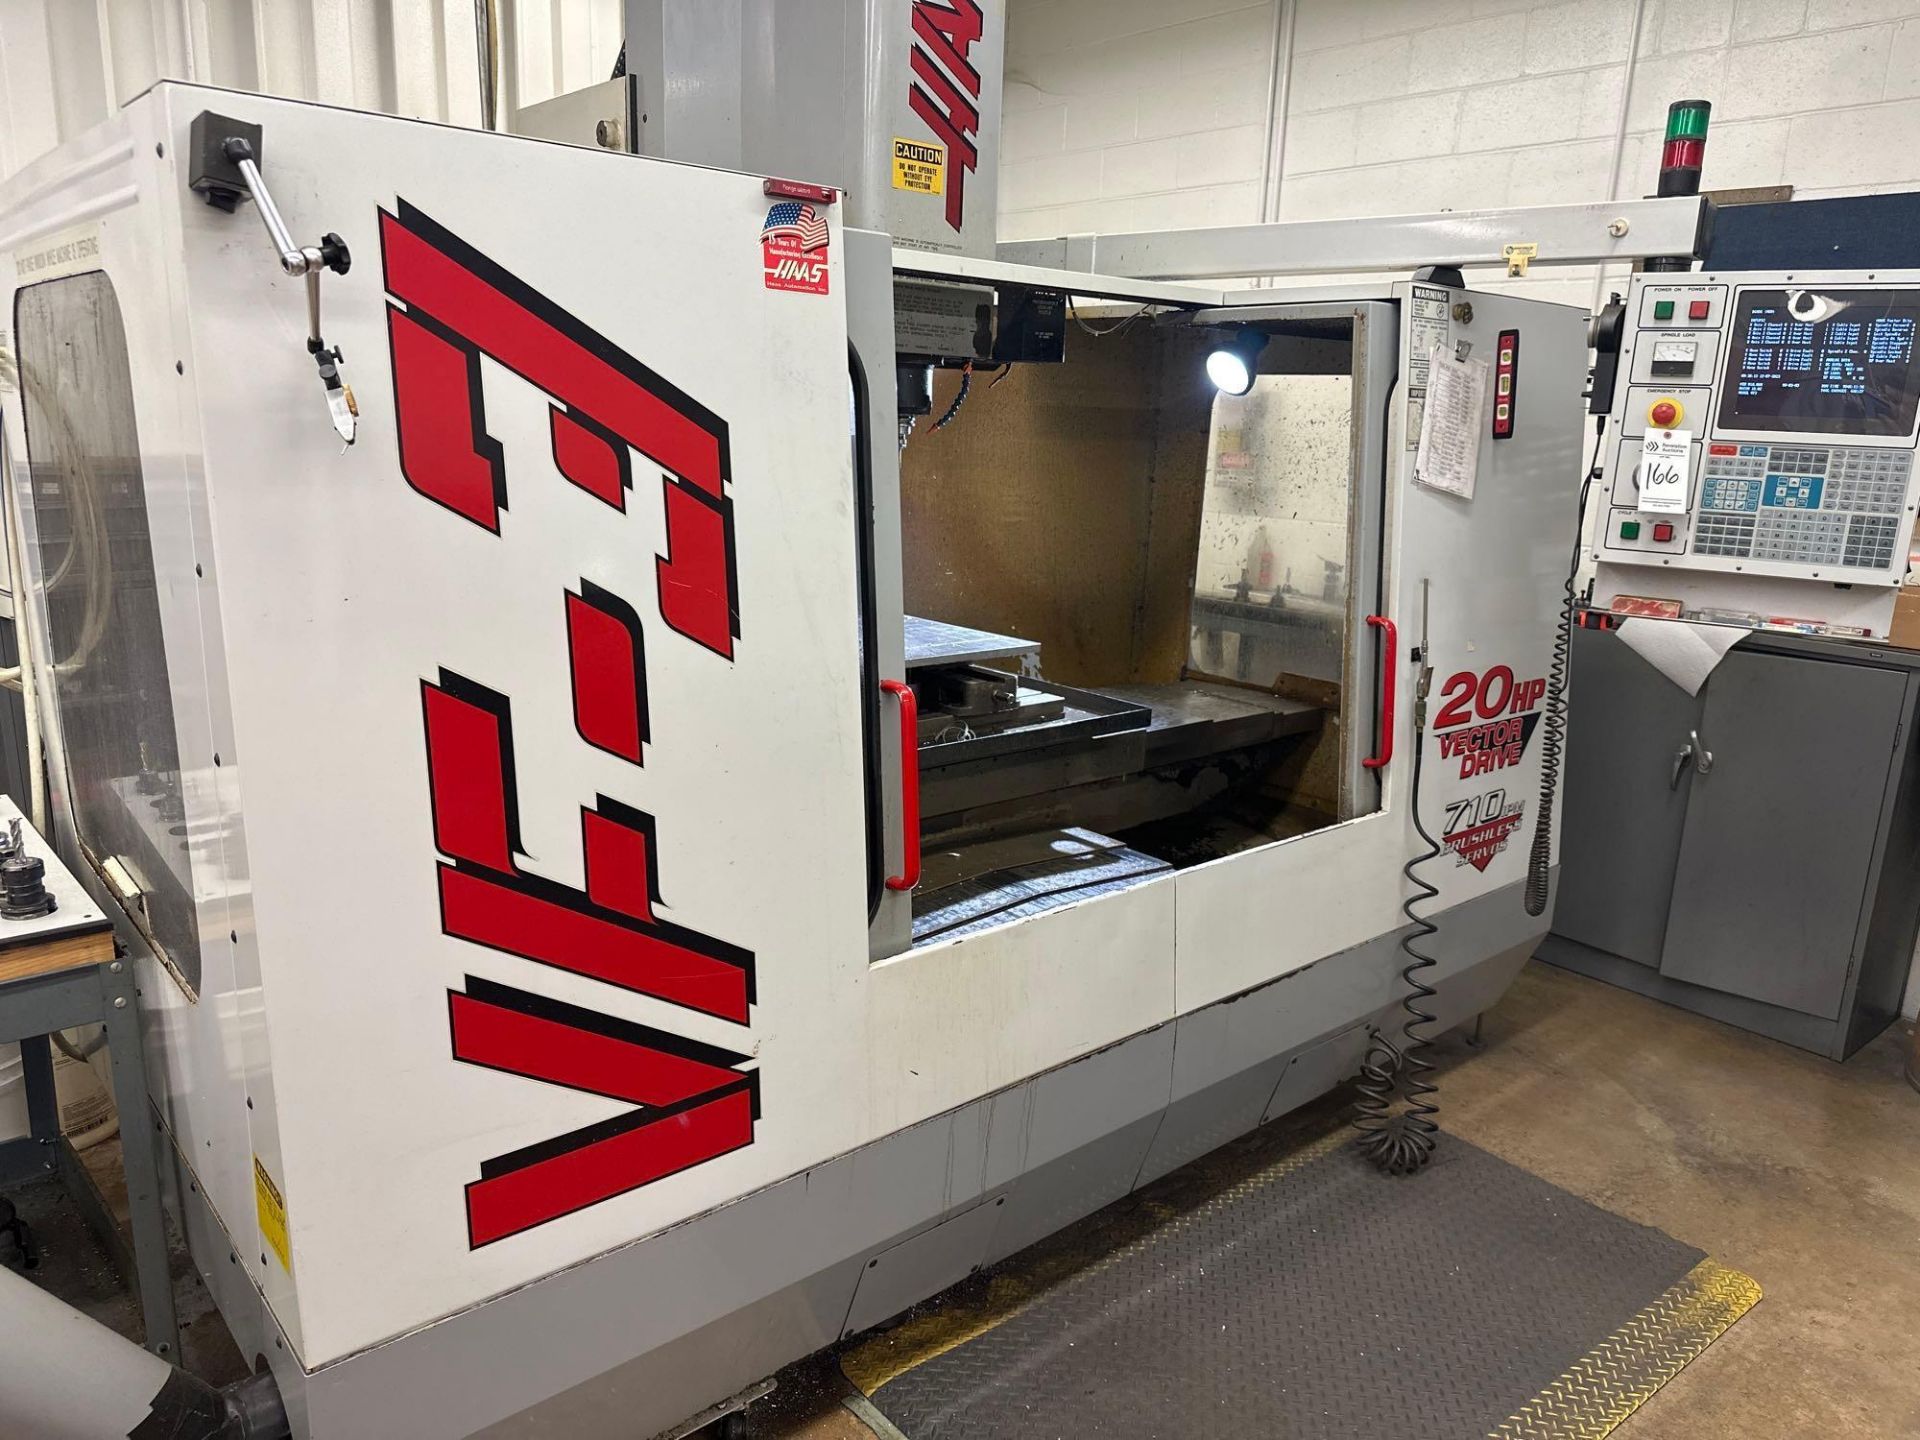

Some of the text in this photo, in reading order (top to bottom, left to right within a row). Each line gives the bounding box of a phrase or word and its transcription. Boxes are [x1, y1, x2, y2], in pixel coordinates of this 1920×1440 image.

[896, 143, 942, 164] CAUTION
[903, 172, 922, 181] WITHOUT
[908, 164, 916, 172] NOT
[918, 166, 937, 176] OPERATE
[904, 180, 931, 190] PROTECTION
[769, 232, 775, 245] 15
[765, 259, 828, 283] HAAS
[1414, 287, 1447, 300] WARNING
[1646, 462, 1679, 490] 166
[1440, 717, 1524, 760] VECTOR
[1459, 742, 1522, 780] DRIVE
[1443, 788, 1505, 836] 710
[1440, 819, 1523, 857] BRUSHLESS
[1455, 839, 1508, 868] SERVOS
